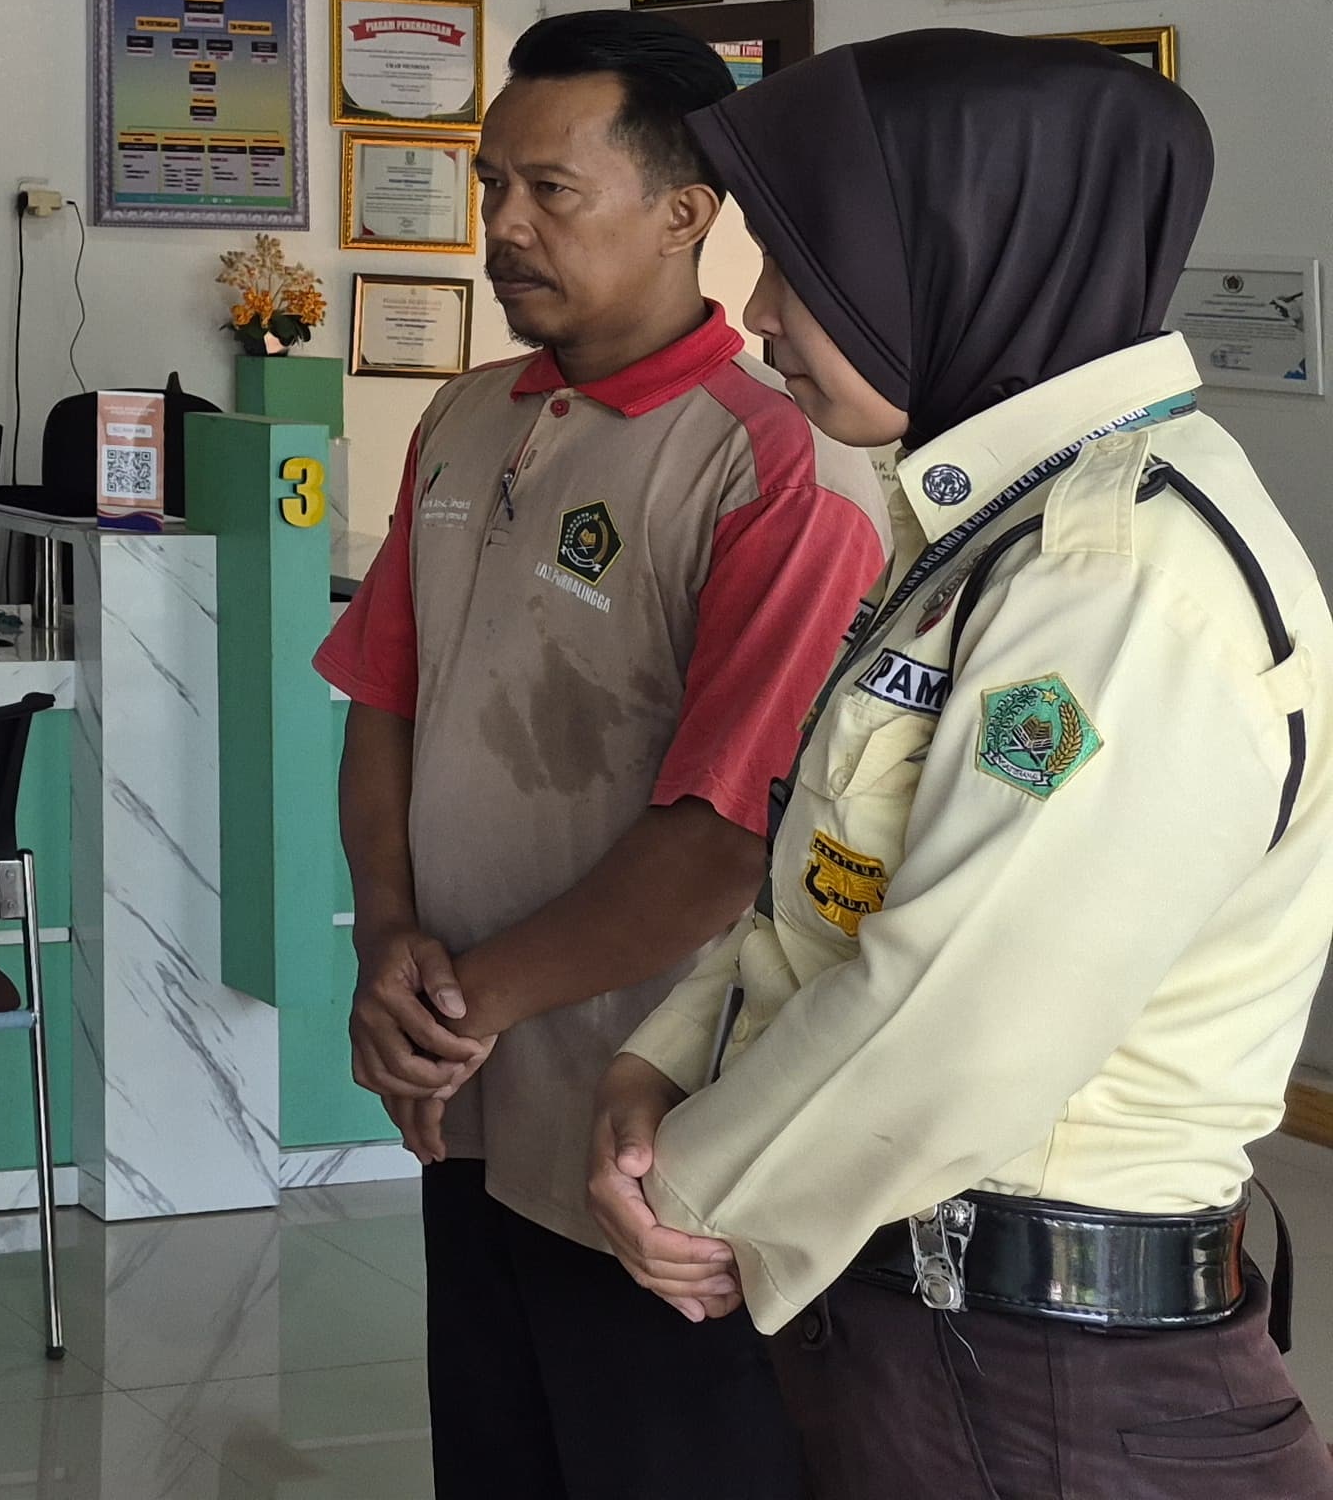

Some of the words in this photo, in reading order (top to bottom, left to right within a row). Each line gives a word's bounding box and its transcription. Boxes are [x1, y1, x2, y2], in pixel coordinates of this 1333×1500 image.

[365, 20, 396, 32] PIAGAM
[396, 20, 452, 36] PENGHARGAAN
[279, 456, 326, 529] 3
[863, 655, 950, 709] PAM
